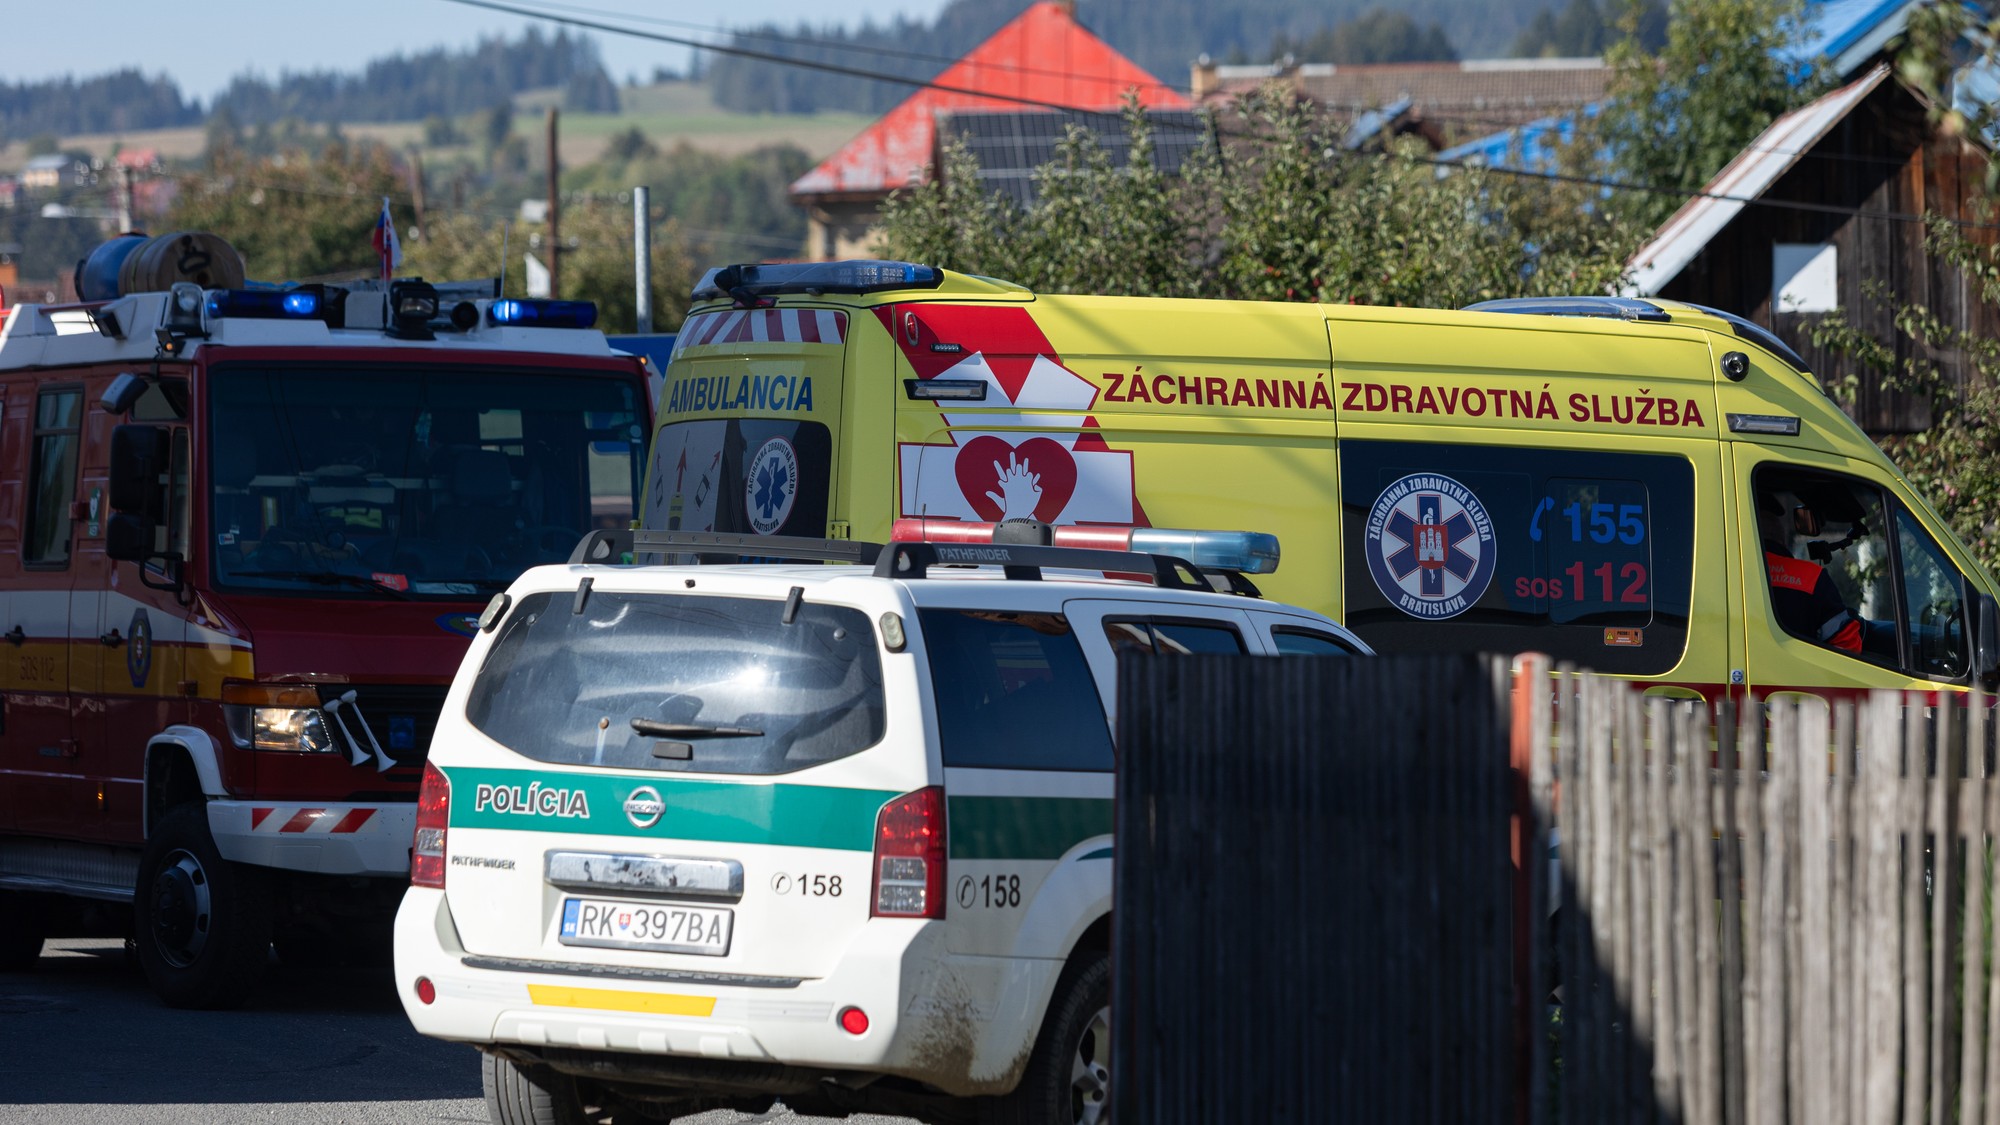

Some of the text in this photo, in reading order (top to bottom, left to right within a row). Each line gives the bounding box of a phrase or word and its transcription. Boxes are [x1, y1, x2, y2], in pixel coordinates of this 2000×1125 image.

[667, 374, 813, 414] AMBULANCIA
[1102, 365, 1705, 428] ZÁCHRANNÁ ZDRAVOTNÁ SLUŽBA
[1369, 477, 1492, 542] ZÁCHRANNÁ ZDRAVOTNÁ SLUŽBA
[1563, 502, 1645, 545] 155
[939, 548, 1012, 561] PATHFINDER
[1565, 561, 1647, 603] 112
[1399, 593, 1467, 616] BRATISLAVA
[40, 656, 55, 682] 112
[475, 781, 591, 819] POLÍCIA
[451, 855, 516, 870] PATHFINDER
[797, 873, 843, 897] 158
[980, 873, 1021, 909] 158
[580, 905, 617, 937] RK
[632, 909, 722, 945] 397BA
